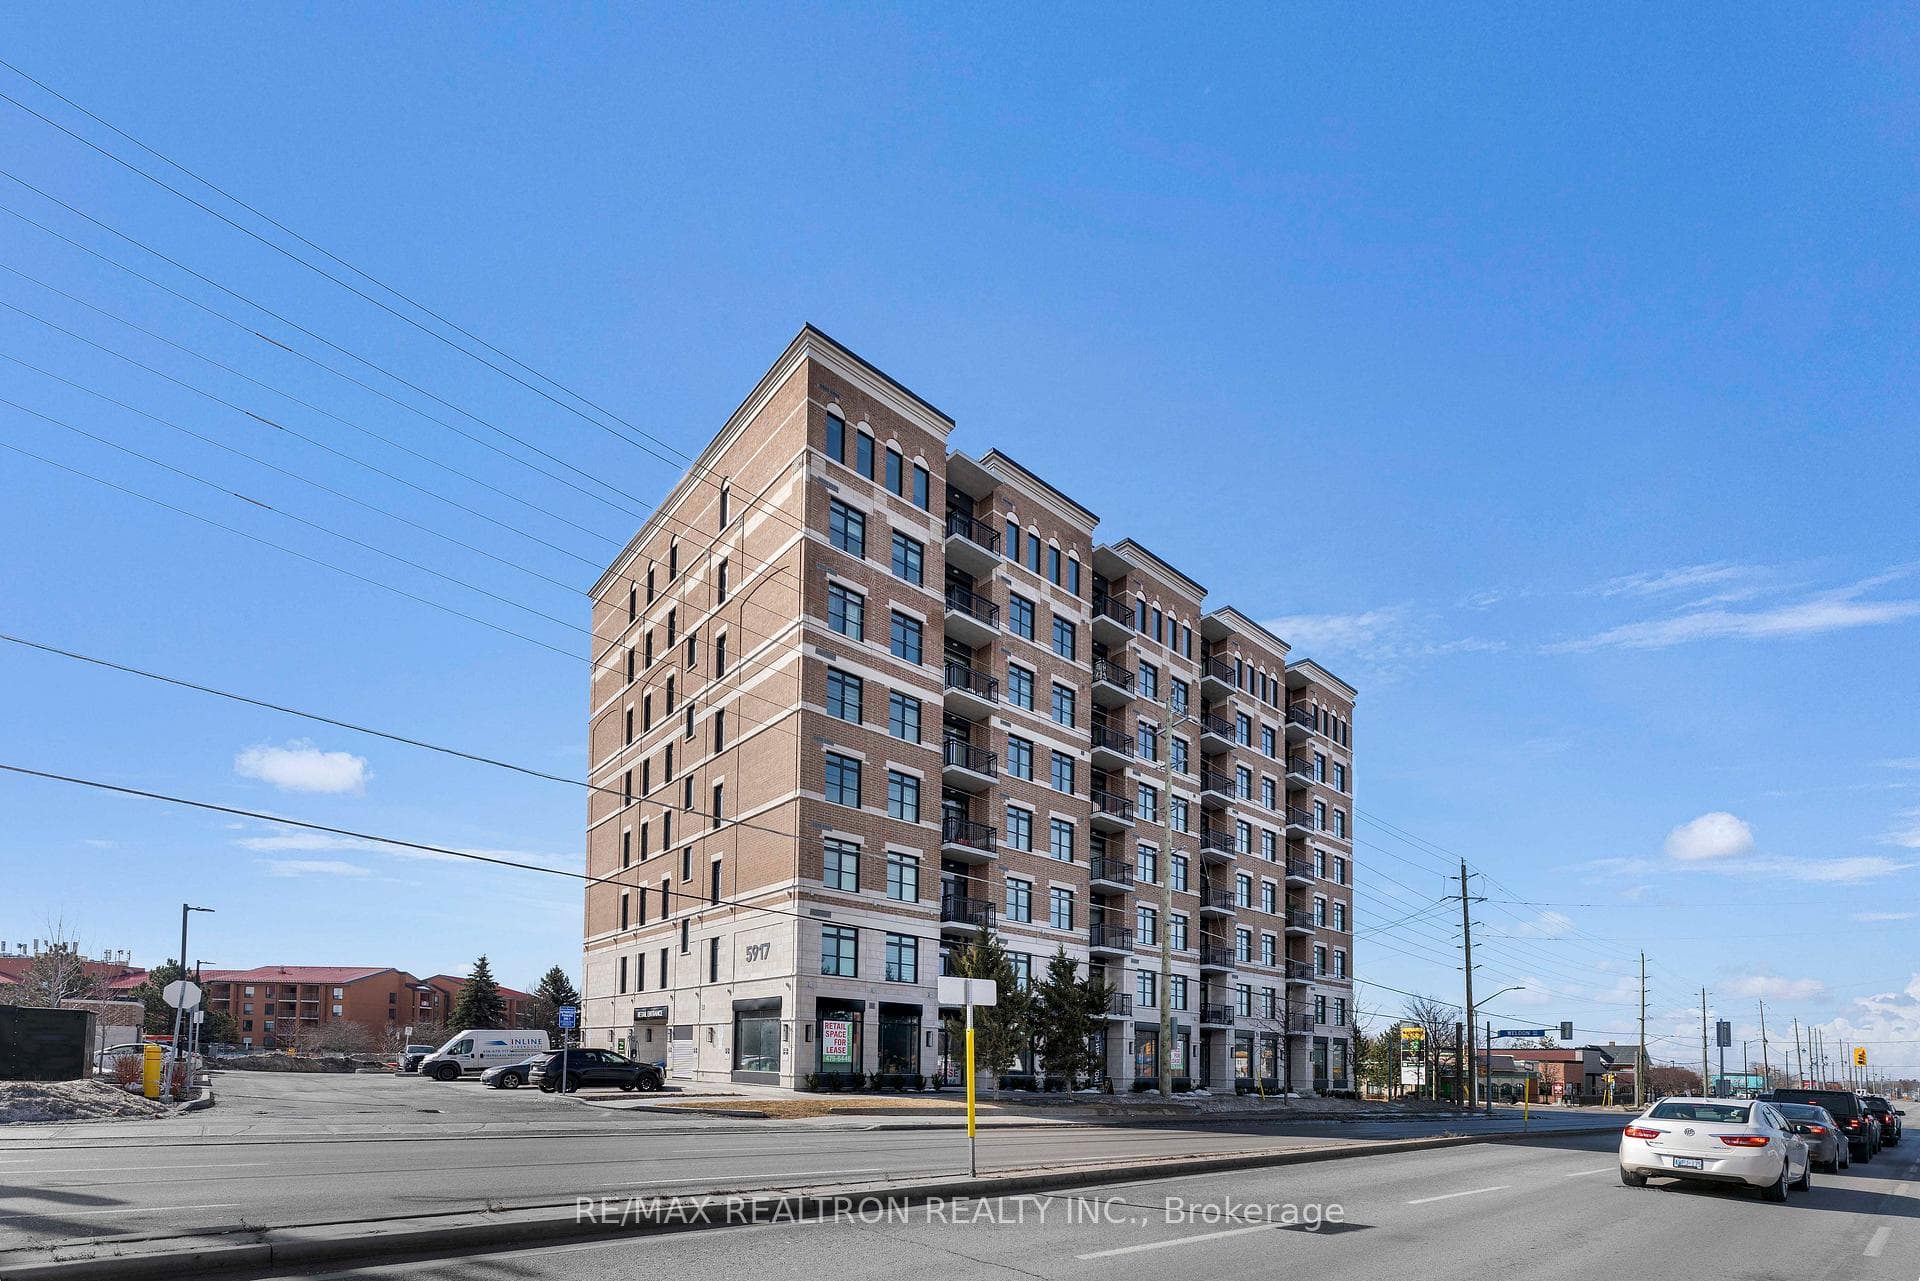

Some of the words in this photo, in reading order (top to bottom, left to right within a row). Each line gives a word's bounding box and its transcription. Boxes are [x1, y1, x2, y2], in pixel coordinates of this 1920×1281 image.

[745, 942, 771, 963] 5917
[824, 1022, 847, 1031] RETAIL
[825, 1030, 847, 1038] SPACE
[511, 1038, 544, 1046] INLINE
[833, 1038, 847, 1046] FOR
[826, 1046, 847, 1054] LEASE
